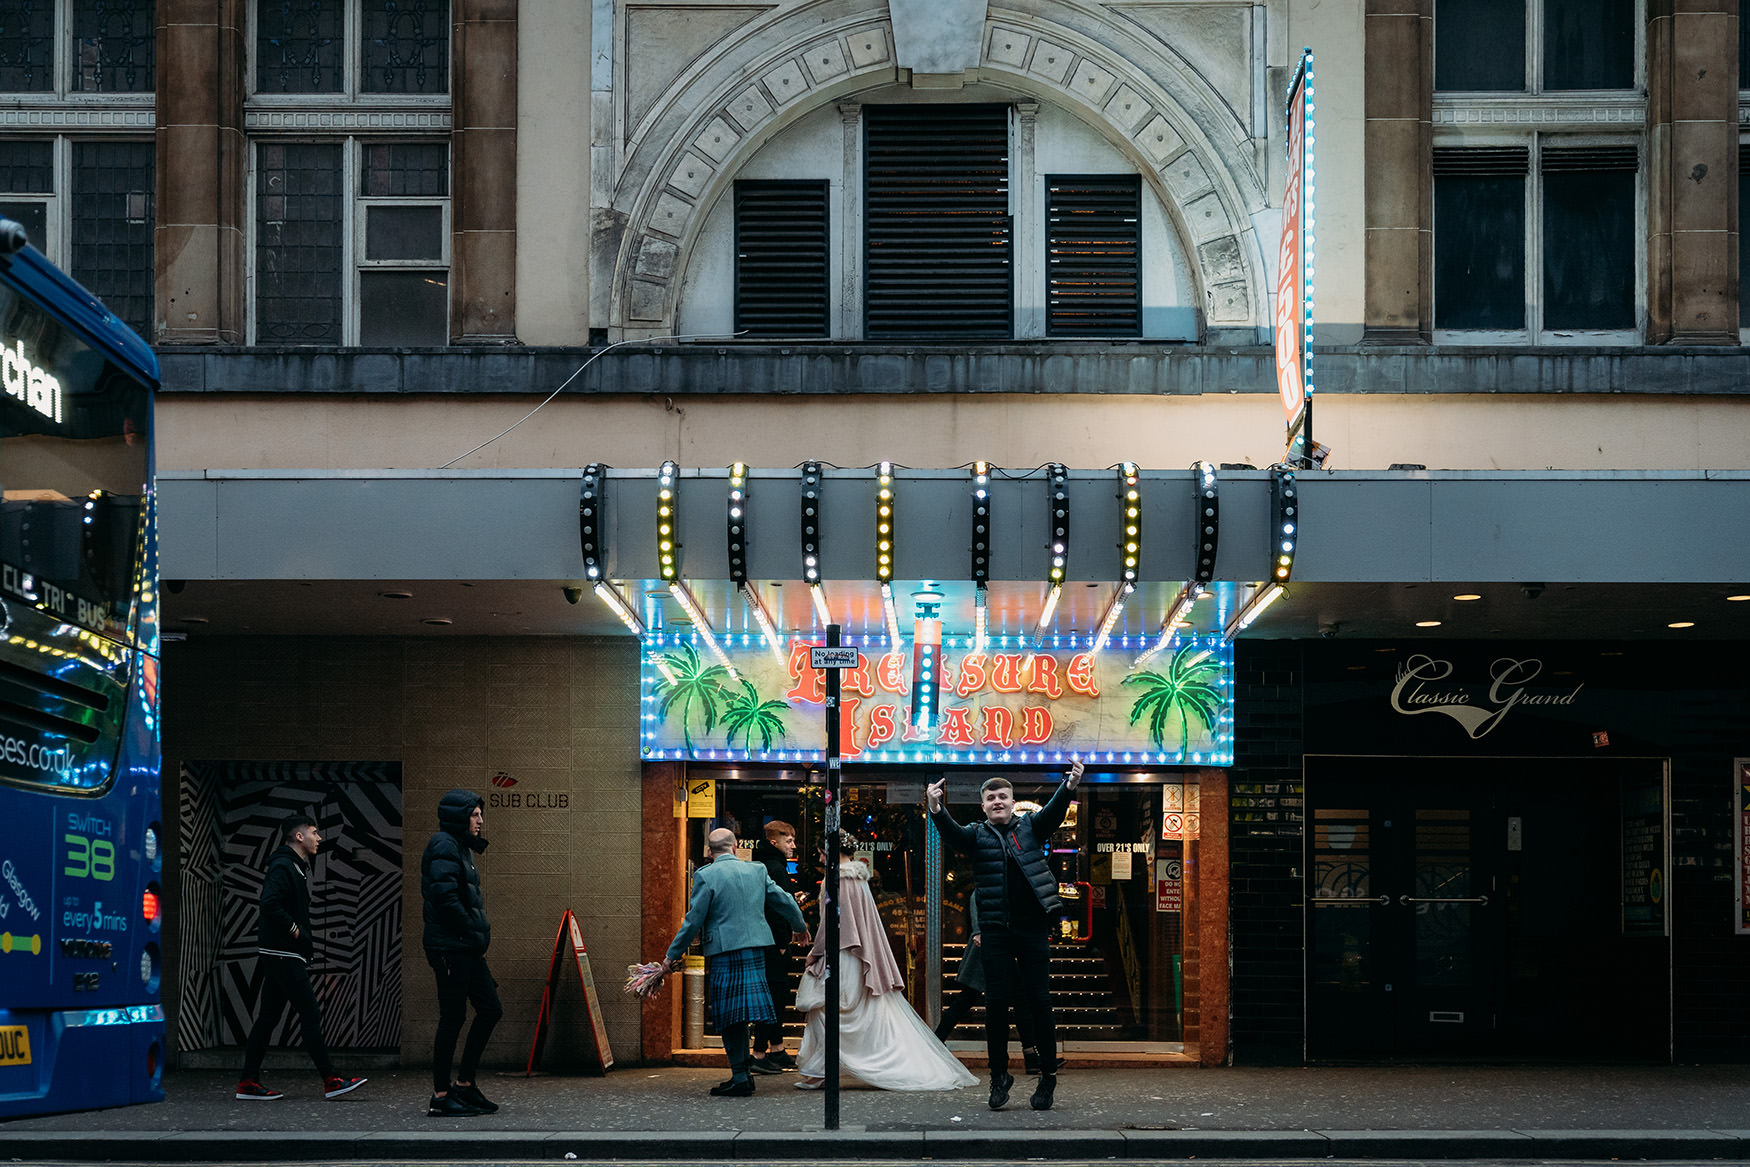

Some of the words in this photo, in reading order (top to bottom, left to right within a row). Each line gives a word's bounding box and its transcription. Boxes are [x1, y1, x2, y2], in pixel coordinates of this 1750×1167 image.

[77, 597, 105, 632] BUS
[1391, 654, 1470, 715] Classic
[1475, 658, 1585, 728] Grand
[490, 793, 521, 808] SUB
[526, 793, 569, 808] CLUB
[67, 813, 112, 836] SWITCH
[64, 834, 115, 881] 38
[860, 842, 875, 851] 21'S
[1097, 843, 1114, 852] OVER
[1116, 843, 1132, 852] 21'S
[1132, 843, 1150, 852] ONLY
[2, 860, 40, 920] Glasgow
[64, 911, 93, 934] every
[94, 902, 102, 929] 5
[103, 910, 127, 932] mins
